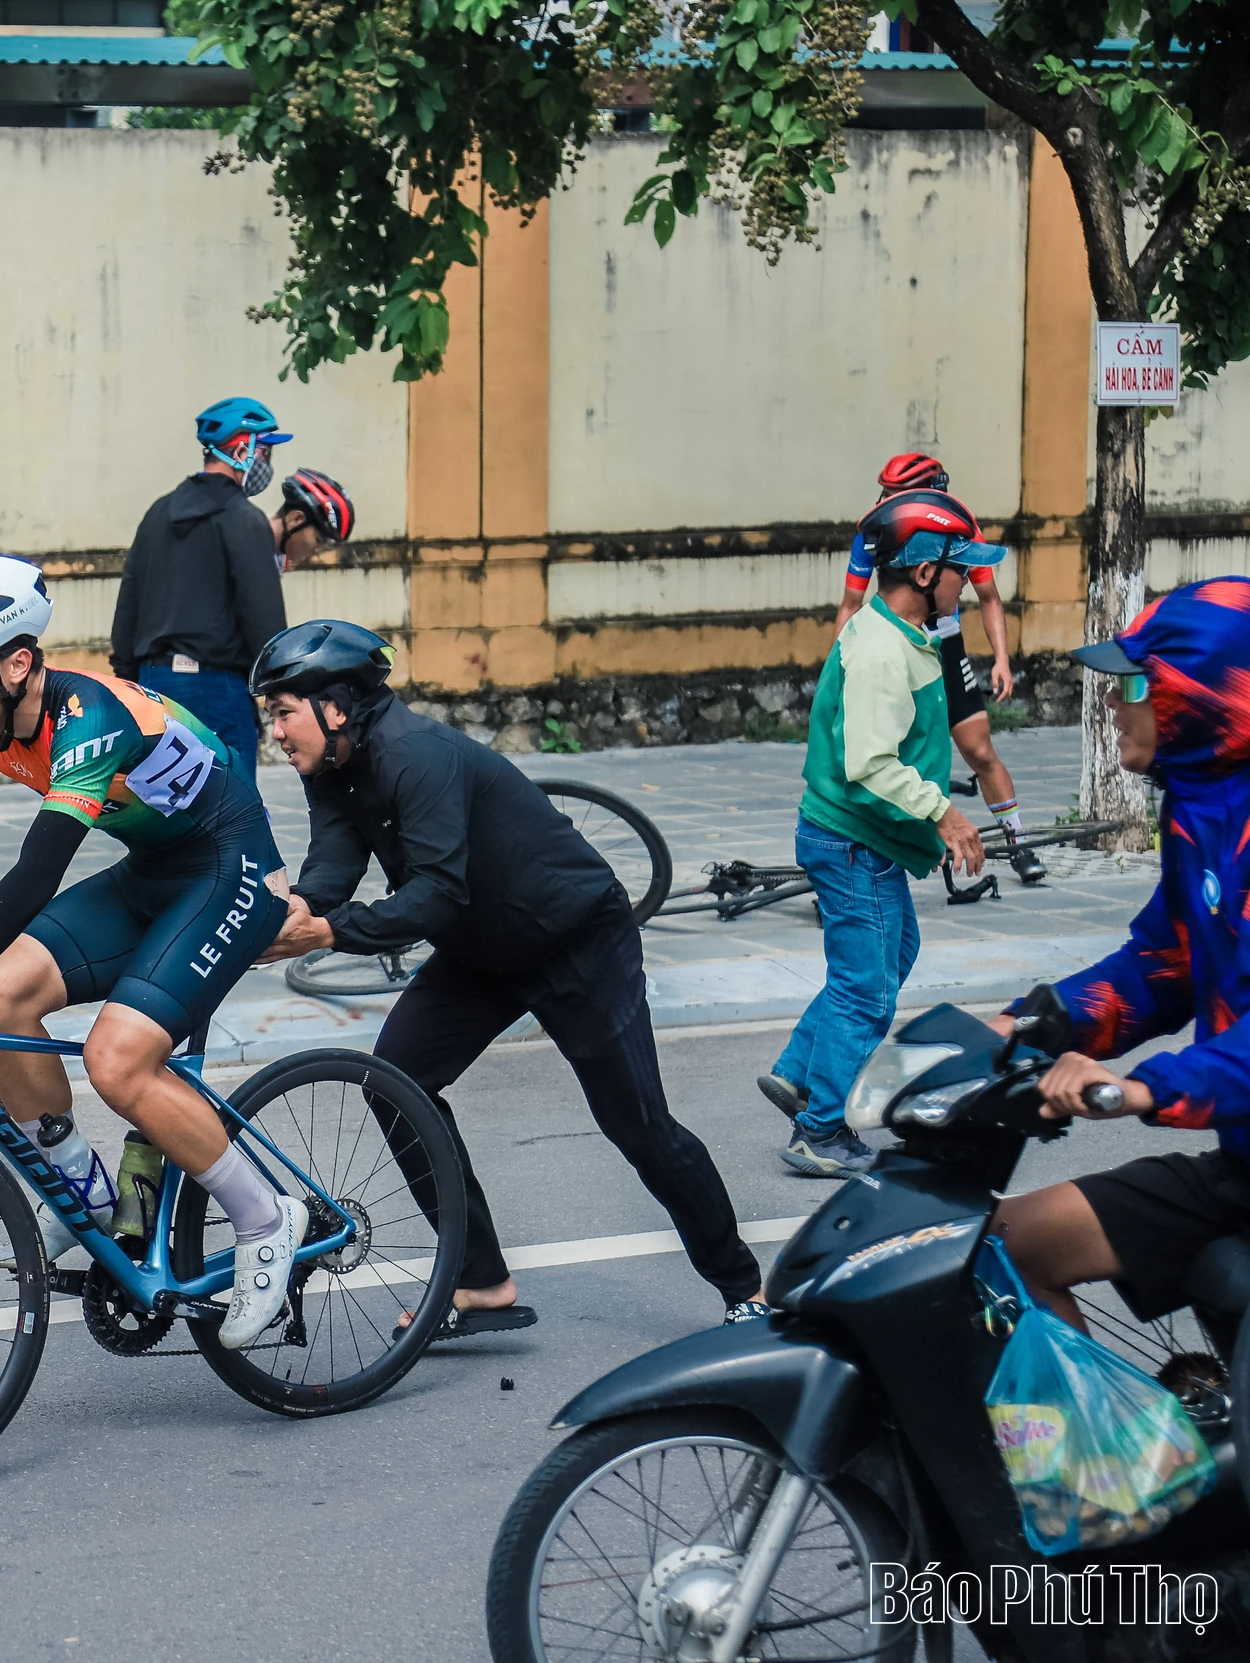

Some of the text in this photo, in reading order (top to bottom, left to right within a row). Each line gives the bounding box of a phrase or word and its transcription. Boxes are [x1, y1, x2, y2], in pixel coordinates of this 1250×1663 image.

[1116, 330, 1163, 355] CẤM
[1121, 366, 1139, 393] HOA,
[1153, 361, 1174, 391] CÀNH
[926, 512, 951, 526] PMT
[0, 609, 18, 625] VAN
[145, 735, 205, 807] 74
[190, 854, 258, 979] LE FRUIT
